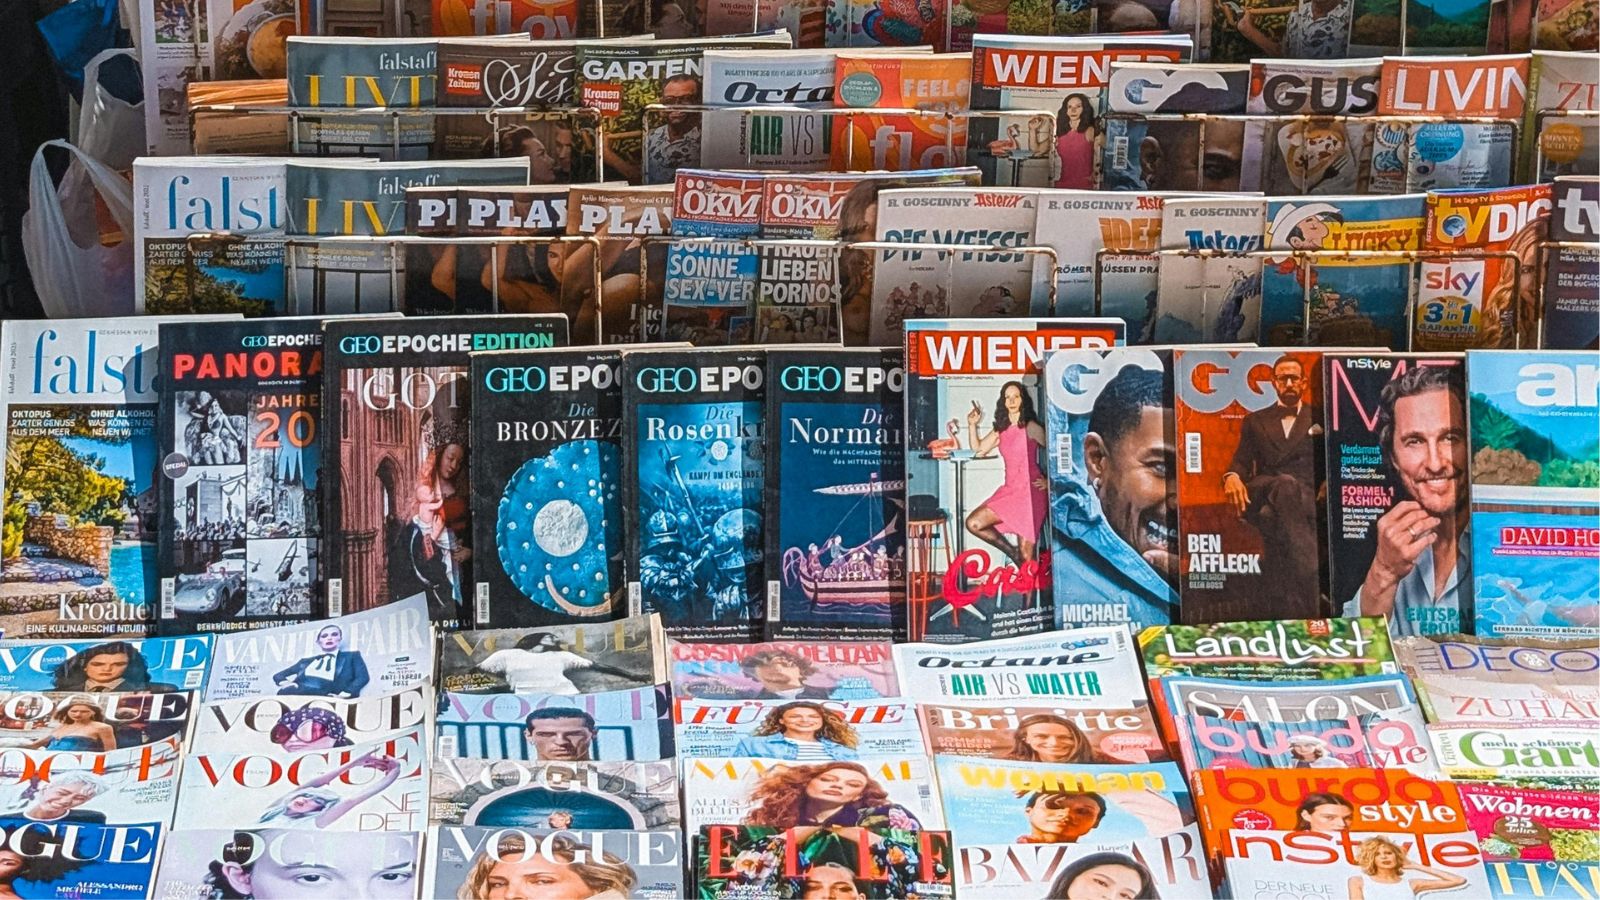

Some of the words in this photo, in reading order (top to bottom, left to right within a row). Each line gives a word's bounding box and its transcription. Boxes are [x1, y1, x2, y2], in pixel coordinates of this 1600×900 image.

[583, 87, 620, 99] Kronen
[750, 115, 784, 156] AIR
[682, 179, 761, 219] ÖKM
[902, 198, 971, 208] GOSCINNY
[1063, 200, 1133, 210] GOSCINNY
[1189, 207, 1259, 217] GOSCINNY
[669, 254, 744, 283] SONNE,
[760, 259, 832, 281] LIEBEN
[667, 278, 756, 301] SEX-VER
[1425, 267, 1481, 297] sky
[1423, 302, 1444, 324] 3
[1446, 310, 1458, 320] in
[1461, 302, 1473, 324] 1
[241, 336, 267, 348] GEO
[268, 333, 323, 347] EPOCHE
[339, 335, 381, 354] GEO
[382, 333, 472, 353] EPOCHE
[473, 332, 554, 351] EDITION
[909, 332, 918, 373] WIENER
[1346, 358, 1392, 371] InStyle
[485, 366, 546, 393] GEO
[636, 366, 697, 393] GEO
[780, 365, 842, 392] GEO
[256, 394, 319, 408] JAHRE
[568, 402, 595, 418] Die
[12, 410, 52, 419] OKTOPUS
[90, 409, 114, 418] OHNE
[706, 404, 734, 420] Die
[861, 408, 894, 426] Die
[12, 418, 42, 427] ZARTER
[43, 418, 76, 427] GENUSS
[12, 427, 28, 436] AUS
[29, 427, 45, 436] DEM
[46, 427, 71, 436] MEER
[88, 418, 106, 427] WAS
[92, 427, 120, 436] NEUEN
[812, 447, 827, 456] Wie
[1341, 485, 1387, 496] FORMEL
[1388, 486, 1395, 497] 1
[1341, 496, 1392, 507] FASHION
[1187, 533, 1221, 553] BEN
[1501, 527, 1568, 546] DAVID
[1188, 553, 1262, 574] AFFLECK
[1062, 603, 1132, 622] MICHAEL
[26, 624, 47, 633] EINE
[48, 623, 116, 633] KULINARISCHE
[225, 630, 318, 664] VANIT
[917, 651, 1115, 669] Octane
[951, 674, 988, 696] AIR
[991, 672, 1022, 696] VS
[1025, 671, 1102, 696] WATER
[958, 764, 1167, 794] woman
[1358, 800, 1457, 828] style
[1466, 793, 1593, 820] Wohnen
[1504, 815, 1534, 828] 25
[449, 828, 679, 867] VOGUE
[706, 826, 953, 885] ELLE
